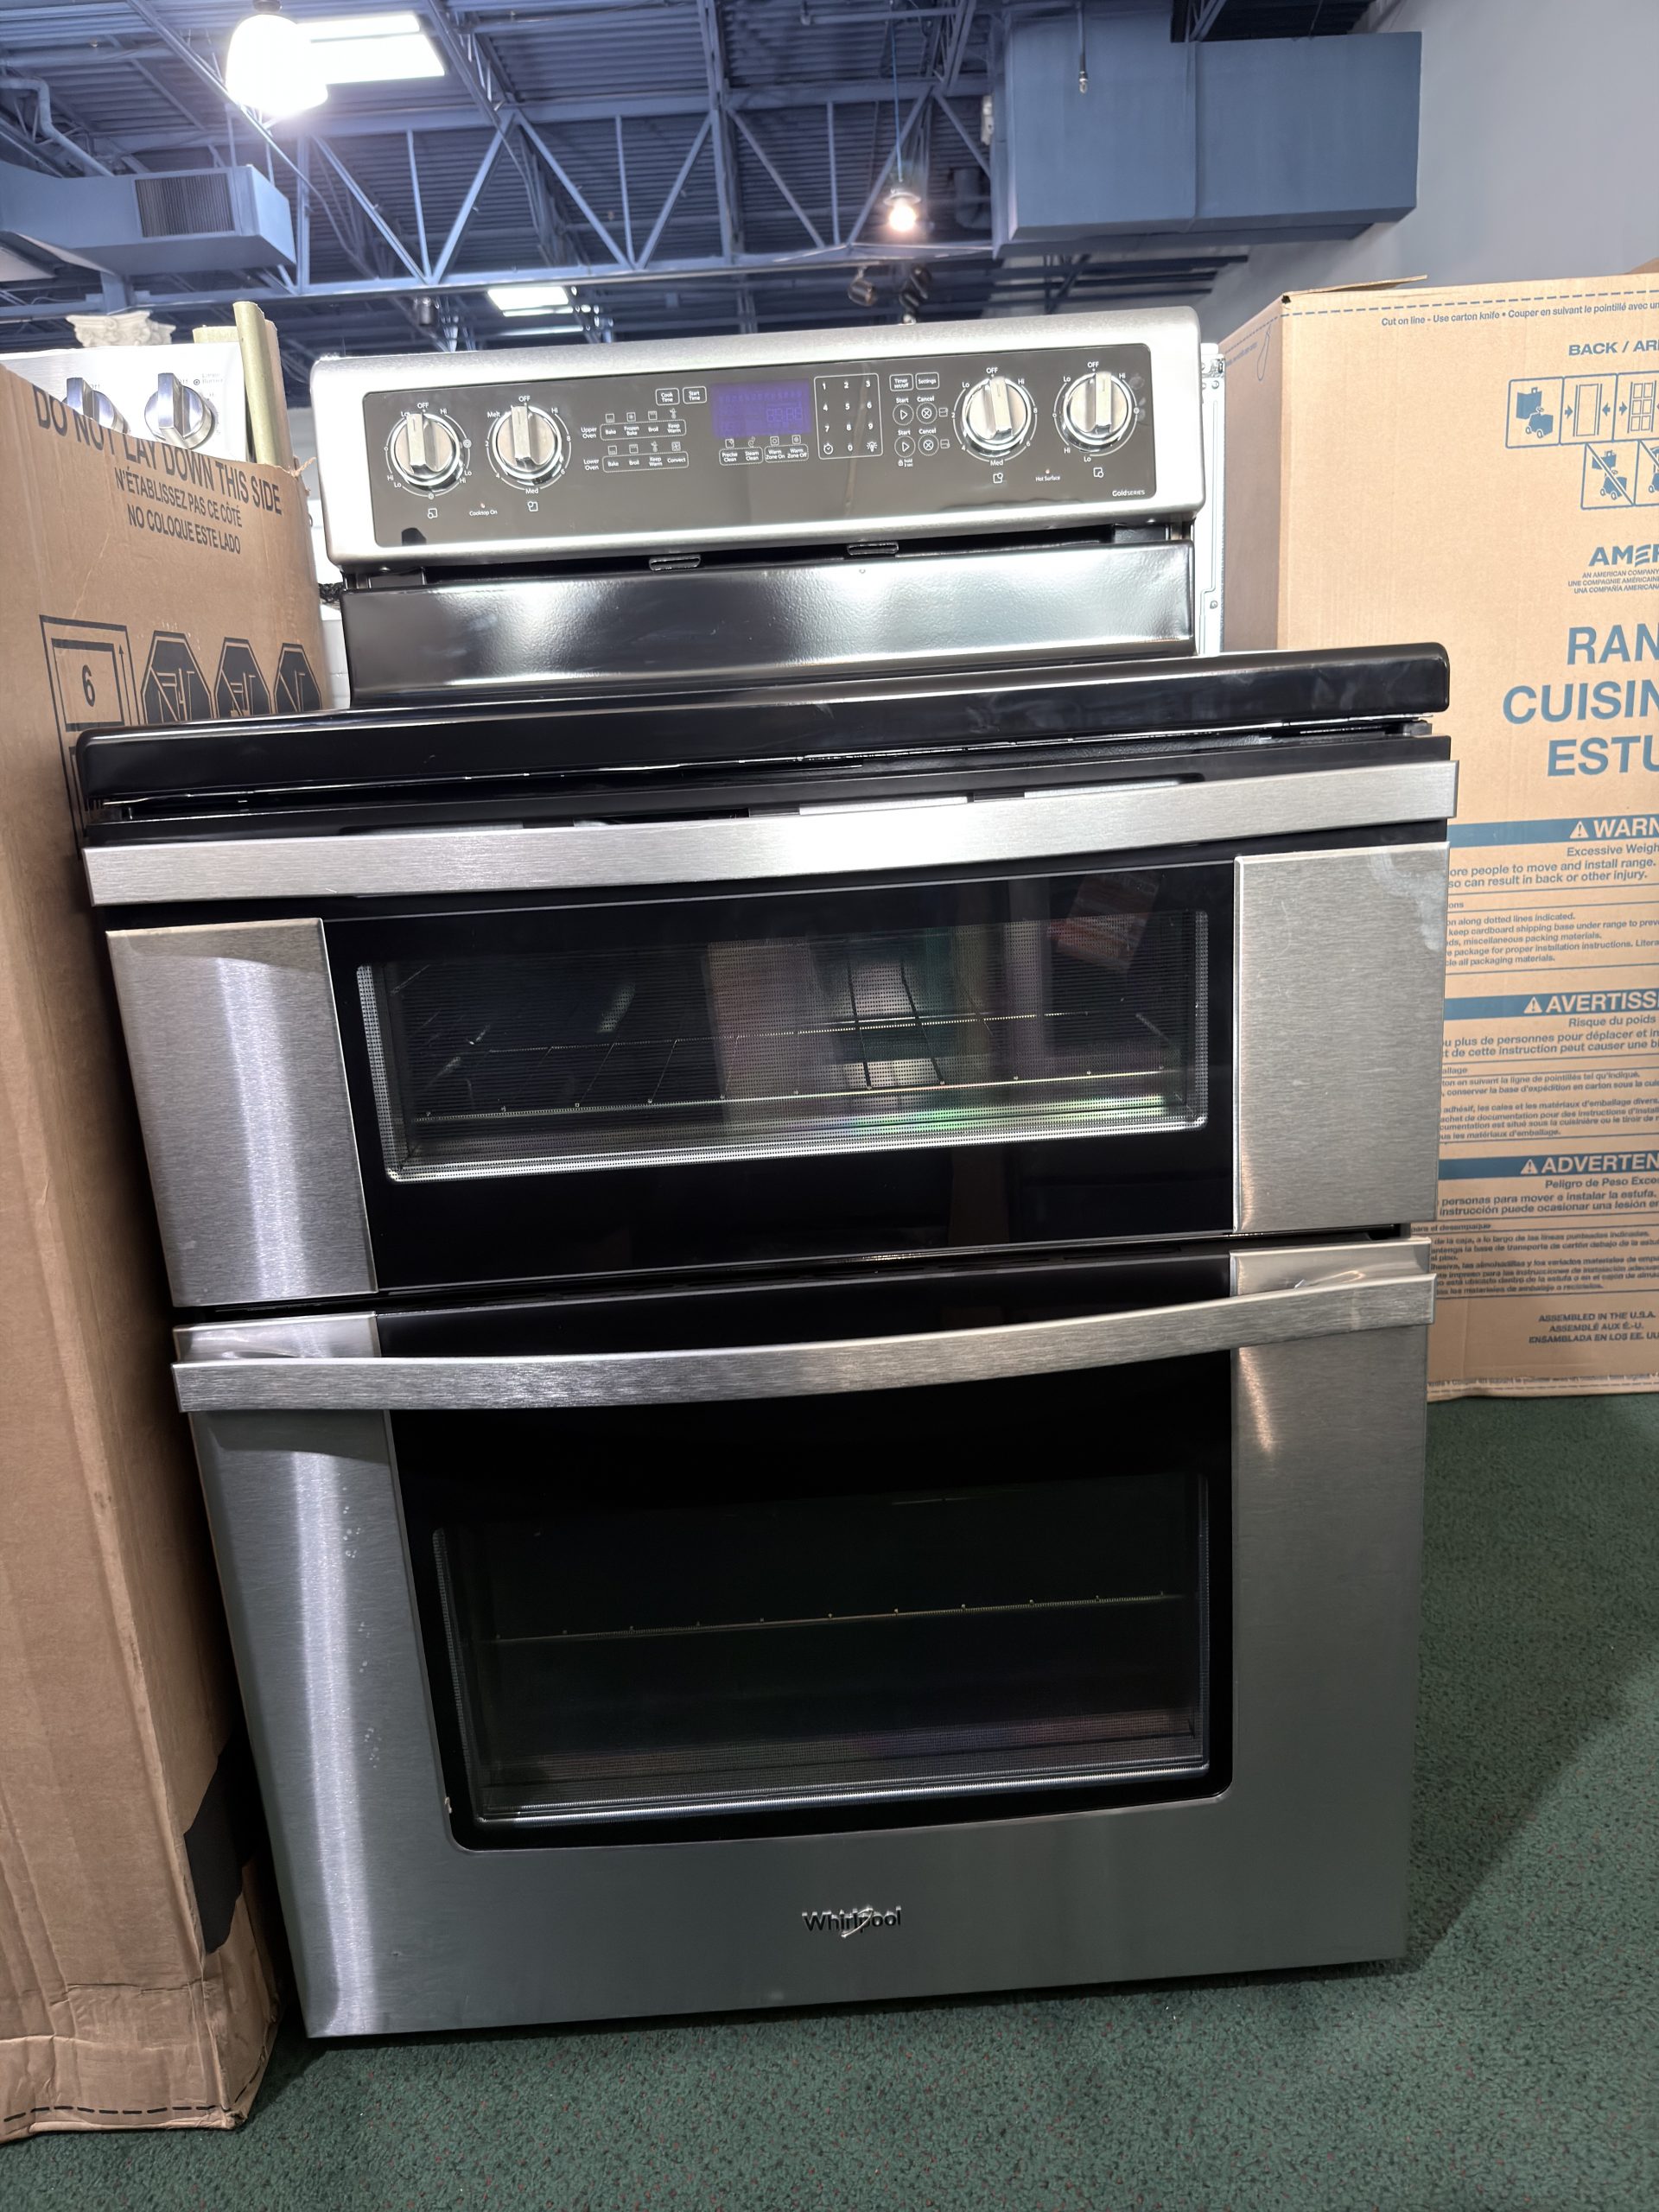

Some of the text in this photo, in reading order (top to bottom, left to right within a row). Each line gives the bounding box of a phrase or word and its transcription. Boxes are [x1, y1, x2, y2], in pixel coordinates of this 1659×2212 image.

[1410, 316, 1425, 325] line
[1433, 315, 1449, 323] Use
[1451, 312, 1478, 321] carton
[1479, 311, 1499, 321] knife
[1508, 308, 1539, 321] Couper
[1552, 305, 1582, 315] suivant
[1584, 305, 1592, 314] le
[1593, 302, 1626, 315] pointillé
[1568, 342, 1618, 356] BACK
[1622, 341, 1629, 353] /
[162, 442, 214, 491] DOWN
[215, 460, 249, 504] THIS
[251, 475, 283, 515] SIDE
[114, 466, 243, 527] N'ÉTABLISSEZ PAS CE CÔTÉ
[128, 504, 240, 555] NO COLOQUE ESTE LADO
[82, 664, 95, 707] 6
[1567, 846, 1623, 857] Excessive
[1471, 865, 1509, 877] people
[1527, 864, 1556, 873] move
[1560, 861, 1581, 871] and
[1585, 859, 1618, 869] install
[1621, 859, 1656, 868] range.
[1465, 879, 1484, 887] can
[1488, 876, 1519, 886] result
[1522, 875, 1532, 884] in
[1535, 873, 1563, 883] back
[1580, 871, 1611, 880] other
[1613, 868, 1647, 881] injury.
[1449, 927, 1469, 938] keep
[1471, 925, 1514, 935] cardboard
[1516, 923, 1552, 934] shipping
[1554, 922, 1574, 931] base
[1577, 921, 1601, 930] under
[1603, 921, 1627, 931] range
[1569, 1014, 1656, 1030] Risque du poids
[1455, 1029, 1647, 1047] plus de personnes pour déplacer et
[1452, 1040, 1647, 1057] de cette instruction peut causer une
[1546, 1177, 1628, 1190] Peligro de Peso
[1538, 1313, 1596, 1323] ASSEMBLED
[802, 1905, 901, 1934] Whirlpool
